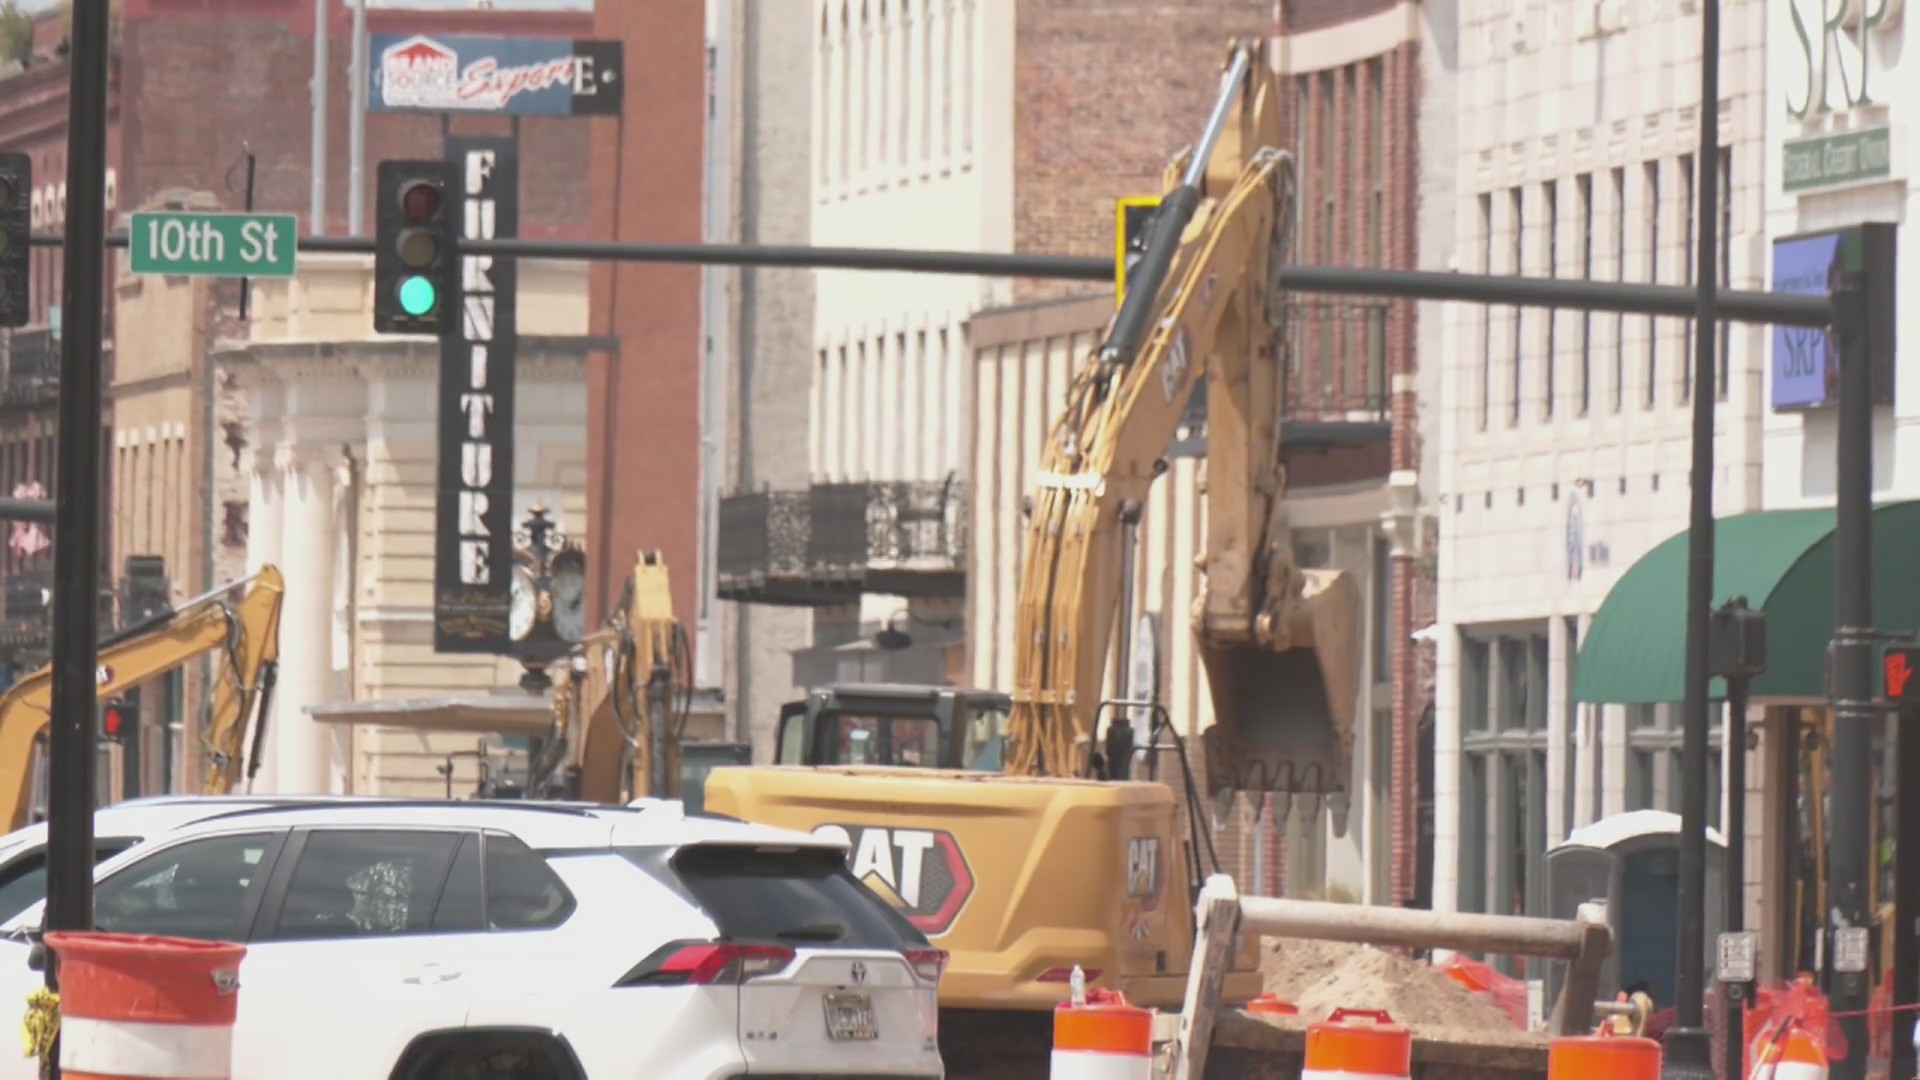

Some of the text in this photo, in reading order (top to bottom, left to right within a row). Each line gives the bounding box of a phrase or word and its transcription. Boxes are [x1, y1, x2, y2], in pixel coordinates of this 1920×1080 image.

[389, 55, 453, 72] BRAND
[148, 219, 279, 263] 10th St
[459, 150, 496, 585] FURNITURE
[1127, 838, 1158, 896] CAT
